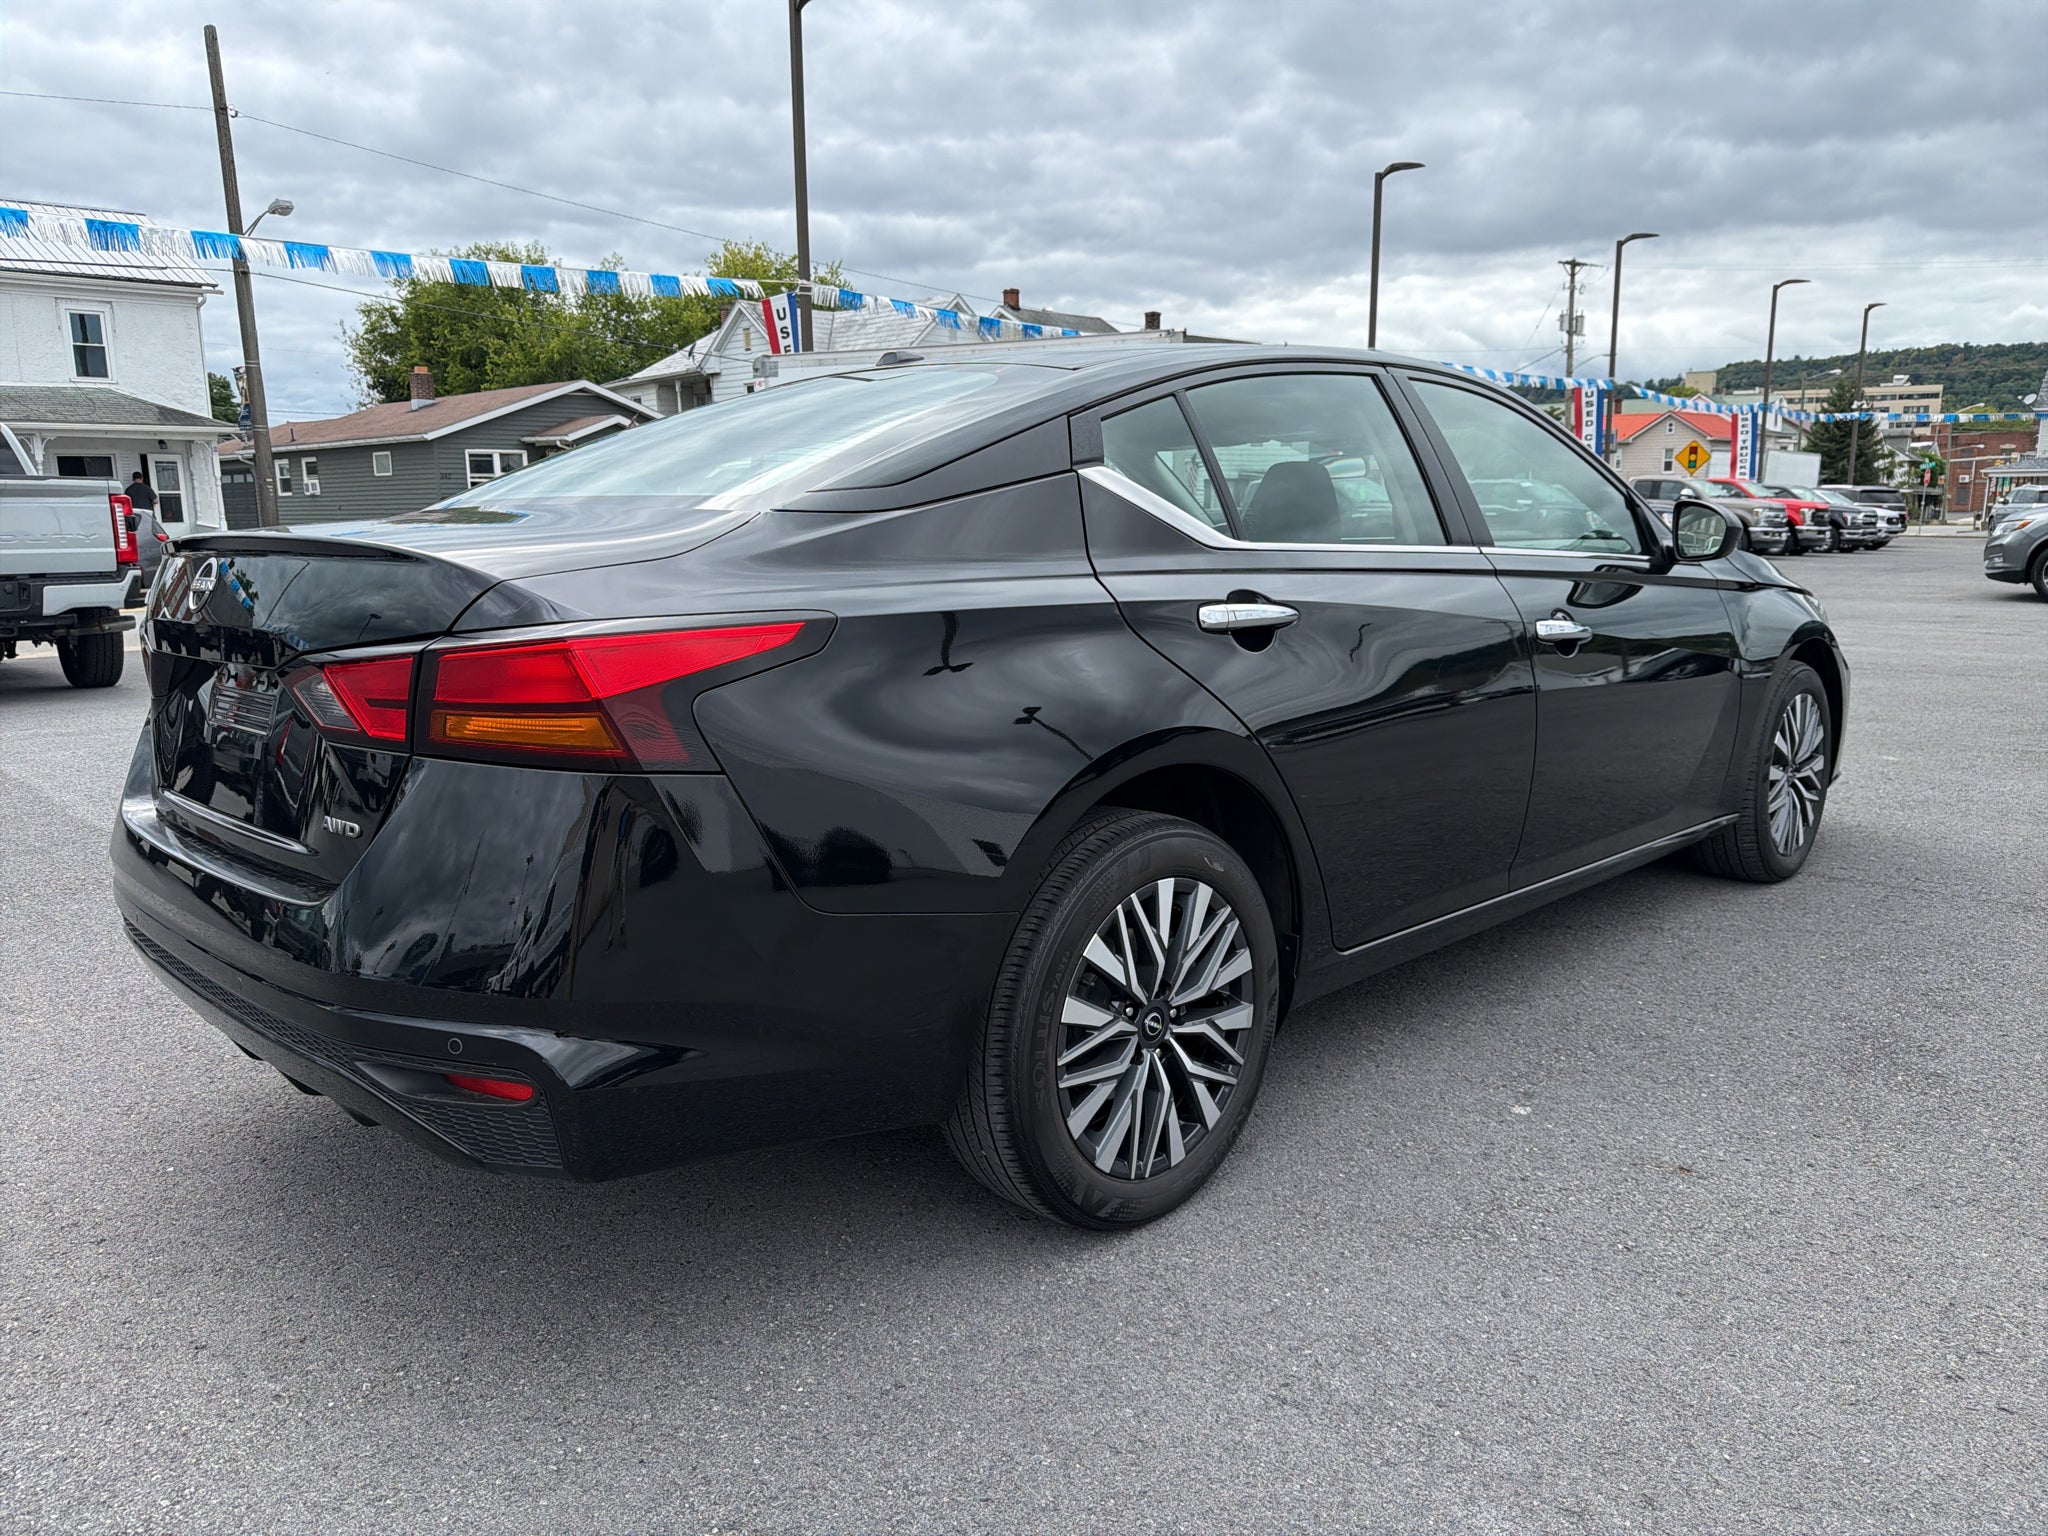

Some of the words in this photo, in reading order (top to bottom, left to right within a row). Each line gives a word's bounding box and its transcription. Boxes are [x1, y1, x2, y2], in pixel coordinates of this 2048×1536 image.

[1584, 390, 1594, 428] USED
[1739, 439, 1749, 477] TRUCKS
[321, 815, 360, 838] AWD
